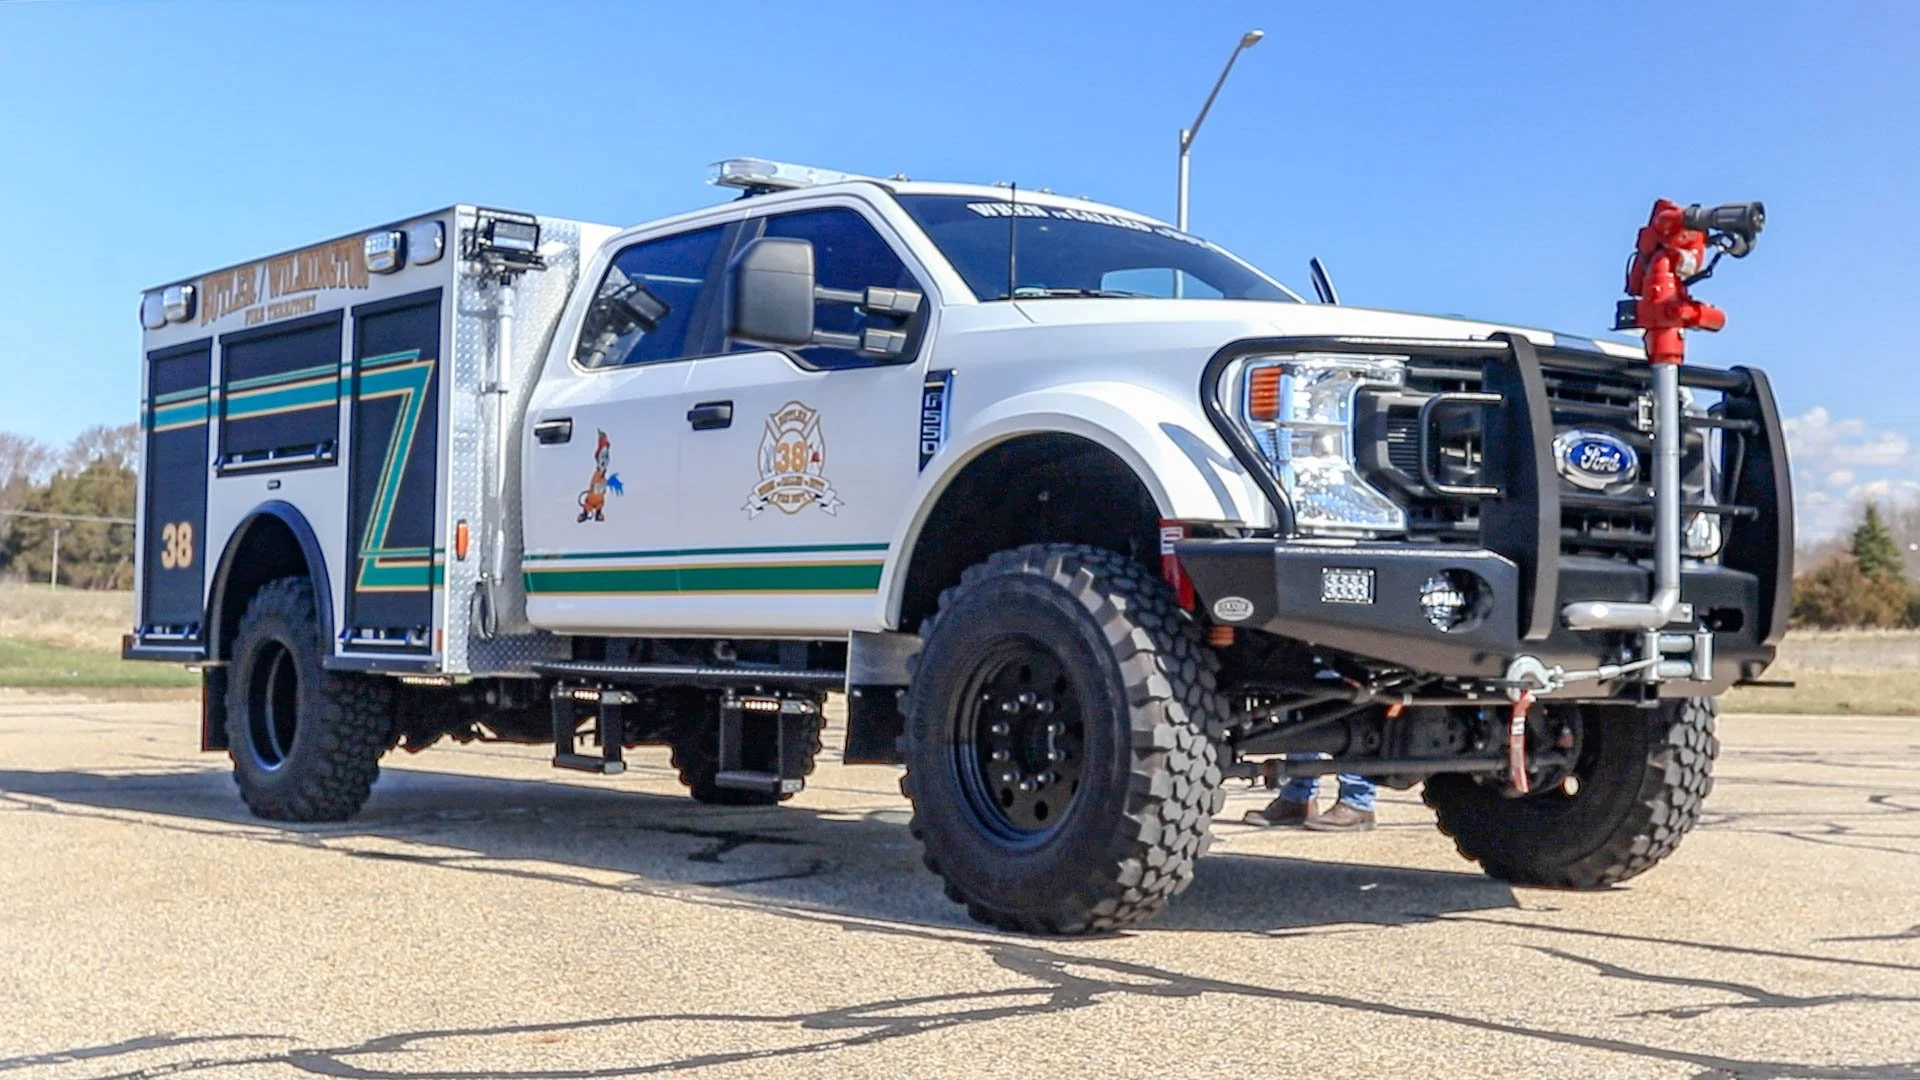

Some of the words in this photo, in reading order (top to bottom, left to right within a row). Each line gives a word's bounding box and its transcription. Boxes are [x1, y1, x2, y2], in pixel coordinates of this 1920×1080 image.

[966, 202, 1049, 218] WHEN
[775, 441, 808, 473] 38
[1580, 444, 1621, 472] Ford
[161, 521, 193, 569] 38
